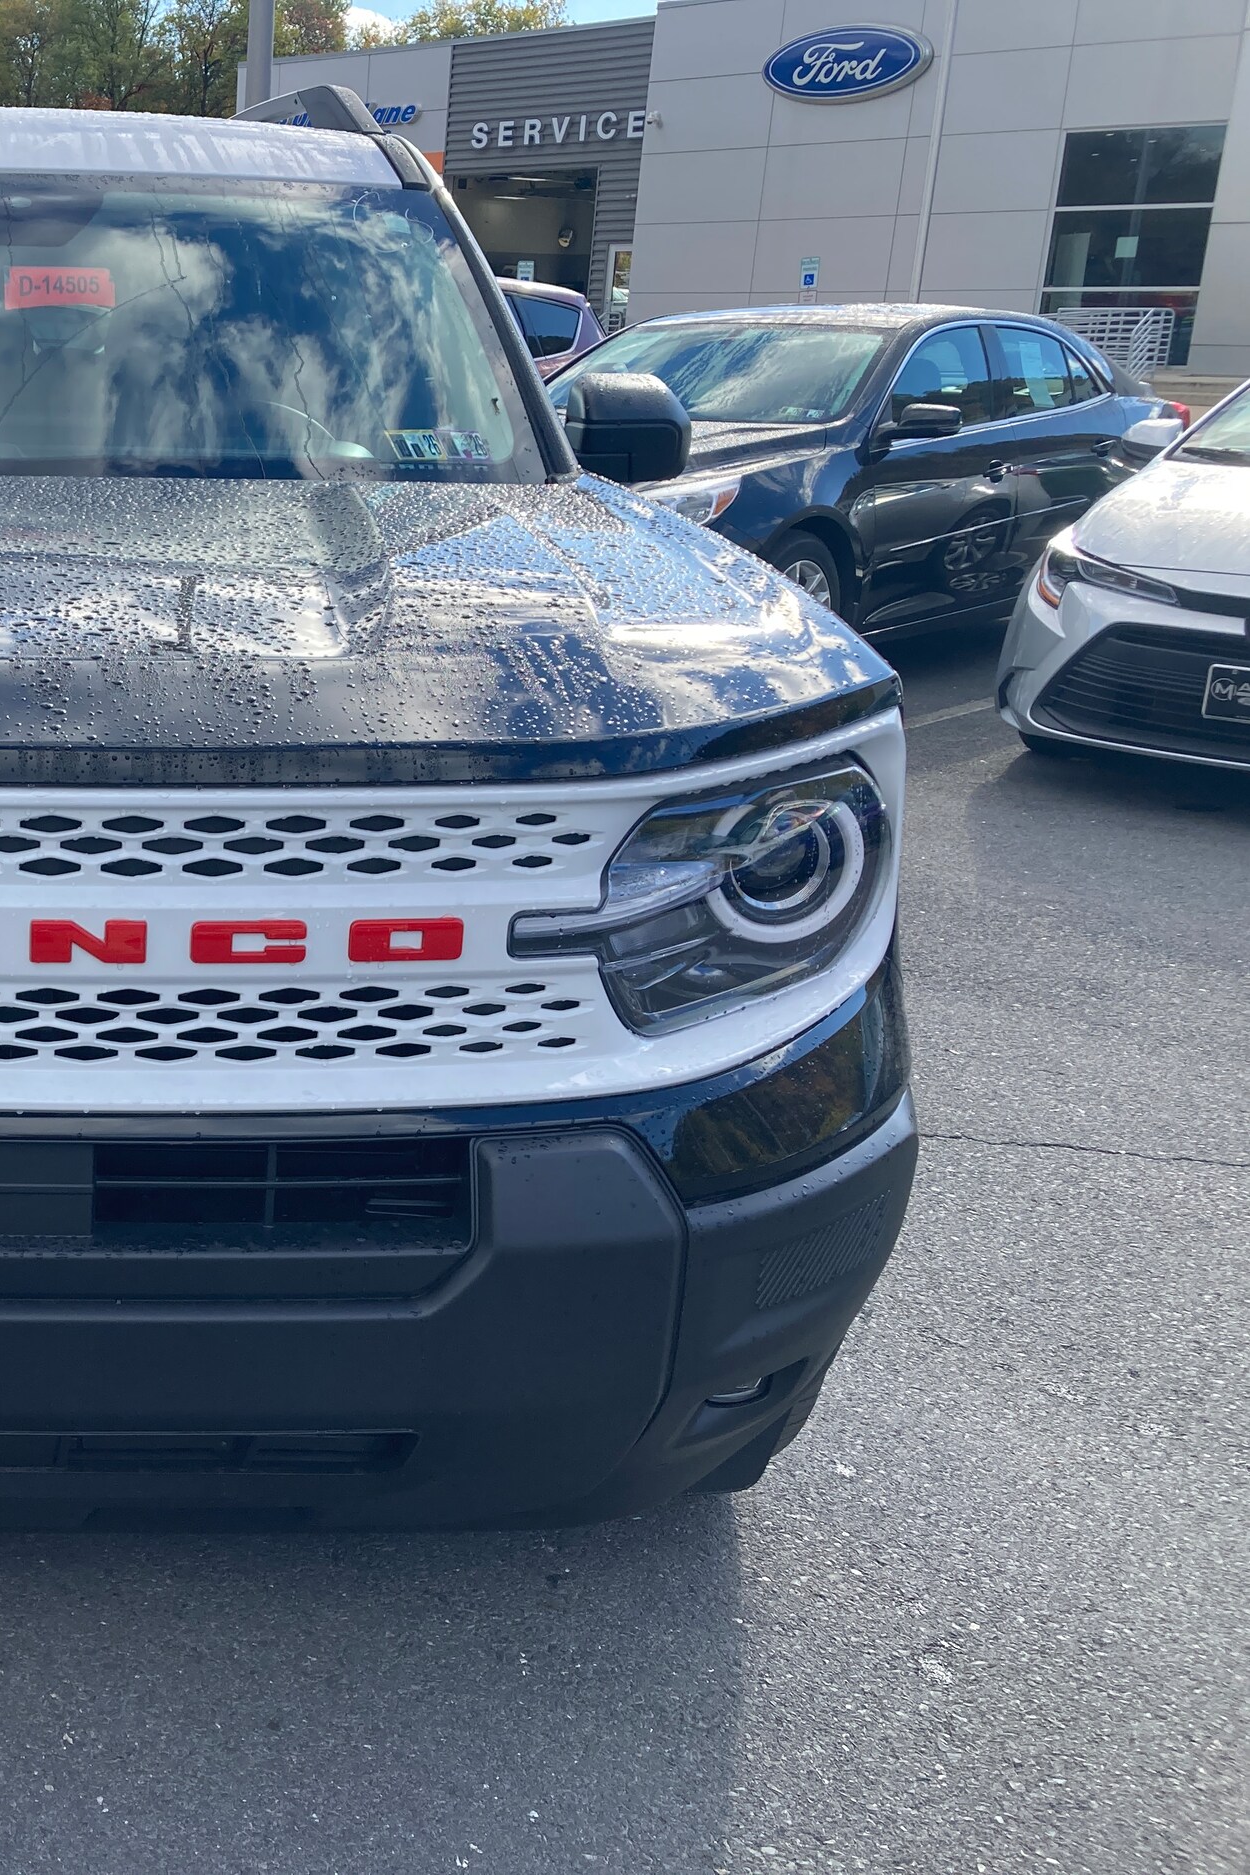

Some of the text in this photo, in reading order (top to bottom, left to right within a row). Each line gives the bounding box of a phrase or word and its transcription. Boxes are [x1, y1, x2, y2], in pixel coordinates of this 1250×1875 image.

[792, 41, 887, 86] Ford
[364, 102, 418, 125] ane
[471, 110, 646, 149] SERVICE
[18, 275, 100, 297] D-14505
